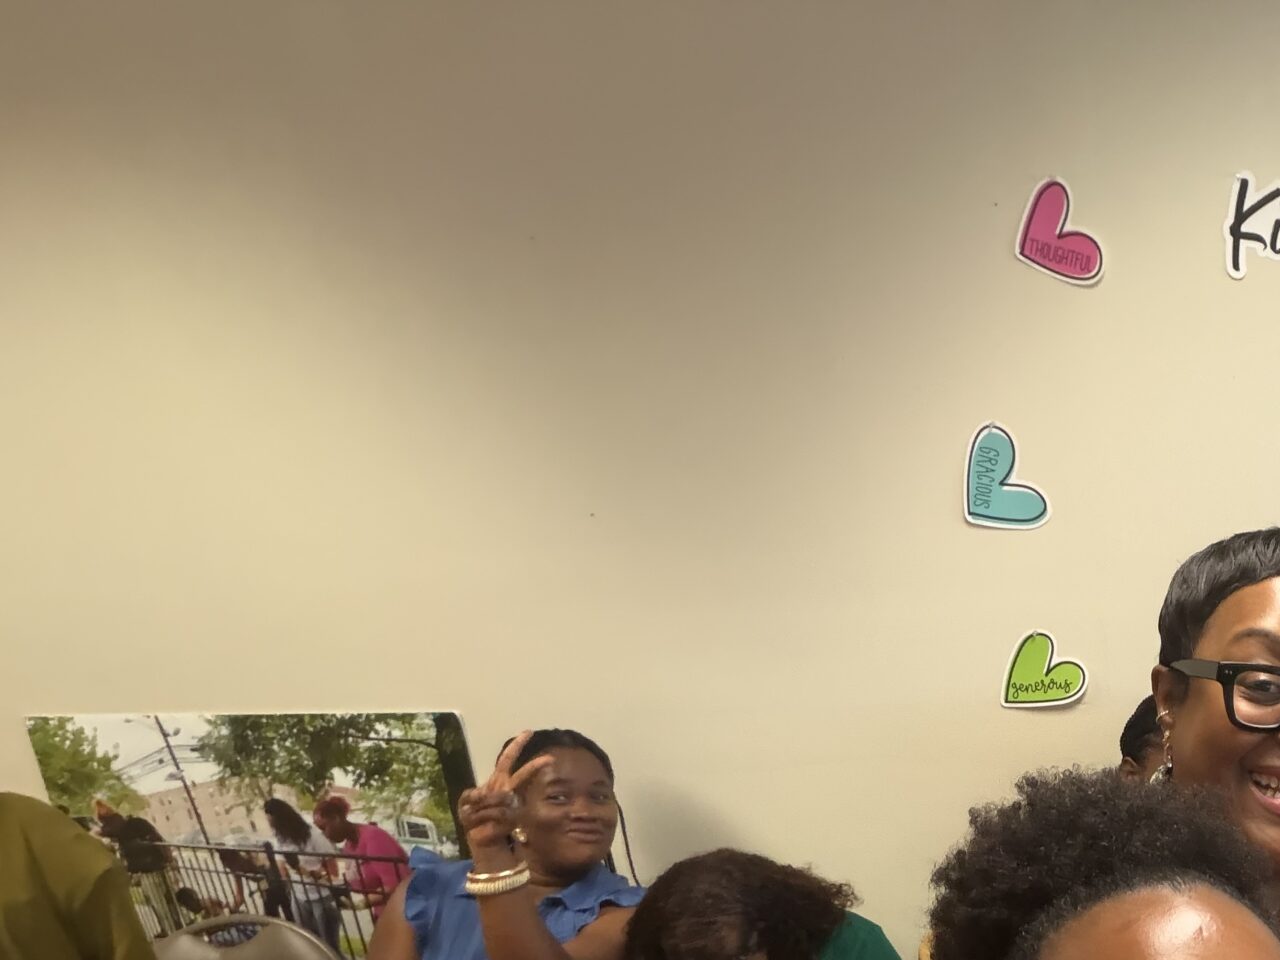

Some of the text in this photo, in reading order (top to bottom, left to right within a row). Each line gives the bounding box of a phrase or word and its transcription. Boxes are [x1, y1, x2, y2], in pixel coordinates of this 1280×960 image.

[1029, 238, 1092, 272] THOUGHTFUL
[973, 446, 1000, 510] GRACIOUS
[1011, 678, 1073, 700] generous
